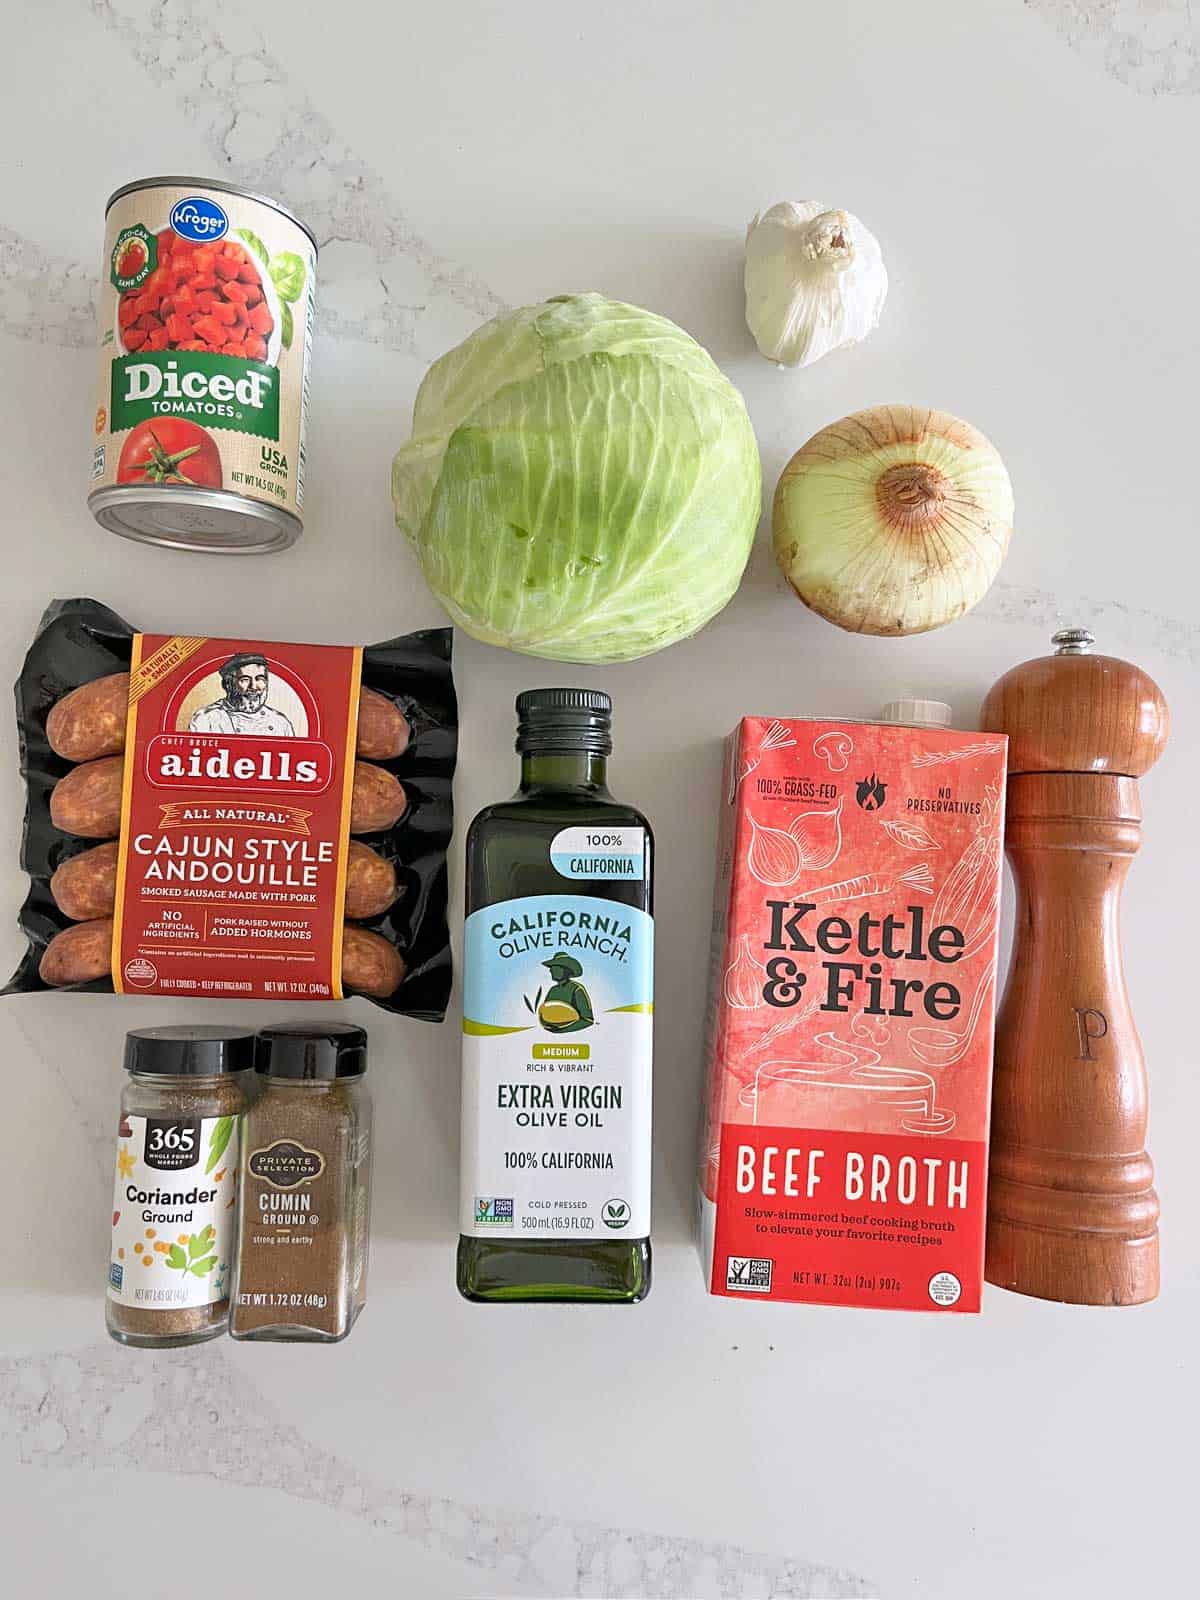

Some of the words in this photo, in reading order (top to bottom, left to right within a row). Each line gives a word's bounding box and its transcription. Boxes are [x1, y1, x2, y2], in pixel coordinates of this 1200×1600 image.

[174, 205, 225, 233] Kroger
[136, 266, 149, 281] DAY
[125, 361, 268, 409] Diced
[152, 401, 234, 417] TOMATOES
[261, 445, 288, 470] USA
[260, 461, 288, 480] GROWN
[231, 471, 243, 484] NET
[244, 474, 254, 486] WT
[140, 642, 178, 677] NATURALLY
[151, 654, 180, 679] SMOKED
[161, 737, 183, 745] CHEF
[189, 738, 219, 747] BRUCE
[160, 748, 318, 782] aidells
[757, 779, 782, 794] 100%
[784, 781, 837, 799] GRASS-FED
[938, 787, 951, 799] NO
[183, 809, 210, 820] ALL
[907, 800, 981, 815] PRESERVATIVES
[134, 834, 234, 858] CAJUN
[245, 839, 333, 863] STYLE
[586, 835, 622, 847] 100%
[144, 860, 318, 887] ANDOUILLE
[570, 858, 634, 874] CALIFORNIA
[141, 887, 180, 897] SMOKED
[183, 889, 226, 899] SAUSAGE
[228, 891, 257, 900] MADE
[260, 892, 288, 901] WITH
[290, 893, 316, 902] PORK
[162, 911, 182, 921] NO
[214, 918, 237, 926] PORK
[238, 919, 268, 927] RAISED
[270, 920, 308, 929] WITHOUT
[143, 929, 200, 939] INGREDIENTS
[148, 922, 194, 931] ARTIFICIAL
[210, 928, 248, 937] ADDED
[251, 929, 312, 940] HORMONES
[490, 911, 632, 943] CALIFORNIA
[764, 900, 966, 964] Kettle
[499, 931, 553, 959] OLIVE
[557, 930, 627, 961] RANCH
[264, 981, 275, 992] NET
[276, 982, 288, 993] WT.
[290, 983, 298, 993] 12
[309, 984, 329, 995] (340g)
[762, 957, 807, 1008] &
[820, 961, 961, 1021] Fire
[542, 1047, 580, 1056] MEDIUM
[526, 1064, 546, 1072] RICH
[549, 1064, 555, 1072] &
[558, 1064, 595, 1073] VIBRANT
[497, 1084, 554, 1109] EXTRA
[560, 1085, 622, 1109] VIRGIN
[516, 1112, 567, 1127] OLIVE
[575, 1113, 603, 1127] OIL
[150, 1126, 195, 1151] 365
[259, 1157, 311, 1165] PRIVATE
[504, 1152, 538, 1169] 100%
[542, 1152, 614, 1169] CALIFORNIA
[257, 1165, 315, 1173] SELECTION
[736, 1144, 825, 1198] BEEF
[846, 1152, 968, 1209] BROTH
[126, 1185, 218, 1205] Coriander
[259, 1193, 311, 1211] CUMIN
[528, 1200, 551, 1209] COLD
[554, 1200, 588, 1209] PRESSED
[142, 1209, 193, 1223] Ground
[263, 1215, 306, 1225] GROUND
[522, 1216, 537, 1229] 500
[538, 1216, 550, 1229] mL
[551, 1216, 569, 1230] (16.9
[744, 1207, 839, 1224] Slow-simmered
[841, 1213, 868, 1226] beef
[870, 1216, 919, 1232] cooking
[921, 1219, 955, 1232] broth
[253, 1236, 274, 1245] strong
[276, 1235, 290, 1244] and
[291, 1236, 313, 1245] earthy
[755, 1225, 768, 1234] to
[769, 1224, 814, 1236] elevate
[815, 1229, 845, 1240] your
[847, 1229, 894, 1243] favorite
[895, 1233, 943, 1247] recipes
[728, 1277, 769, 1286] VERIFIED
[793, 1272, 810, 1284] NET
[814, 1273, 828, 1285] WT.
[252, 1294, 268, 1306] WT
[270, 1294, 289, 1306] 1.72
[290, 1294, 302, 1306] OZ
[304, 1293, 327, 1307] (48g)
